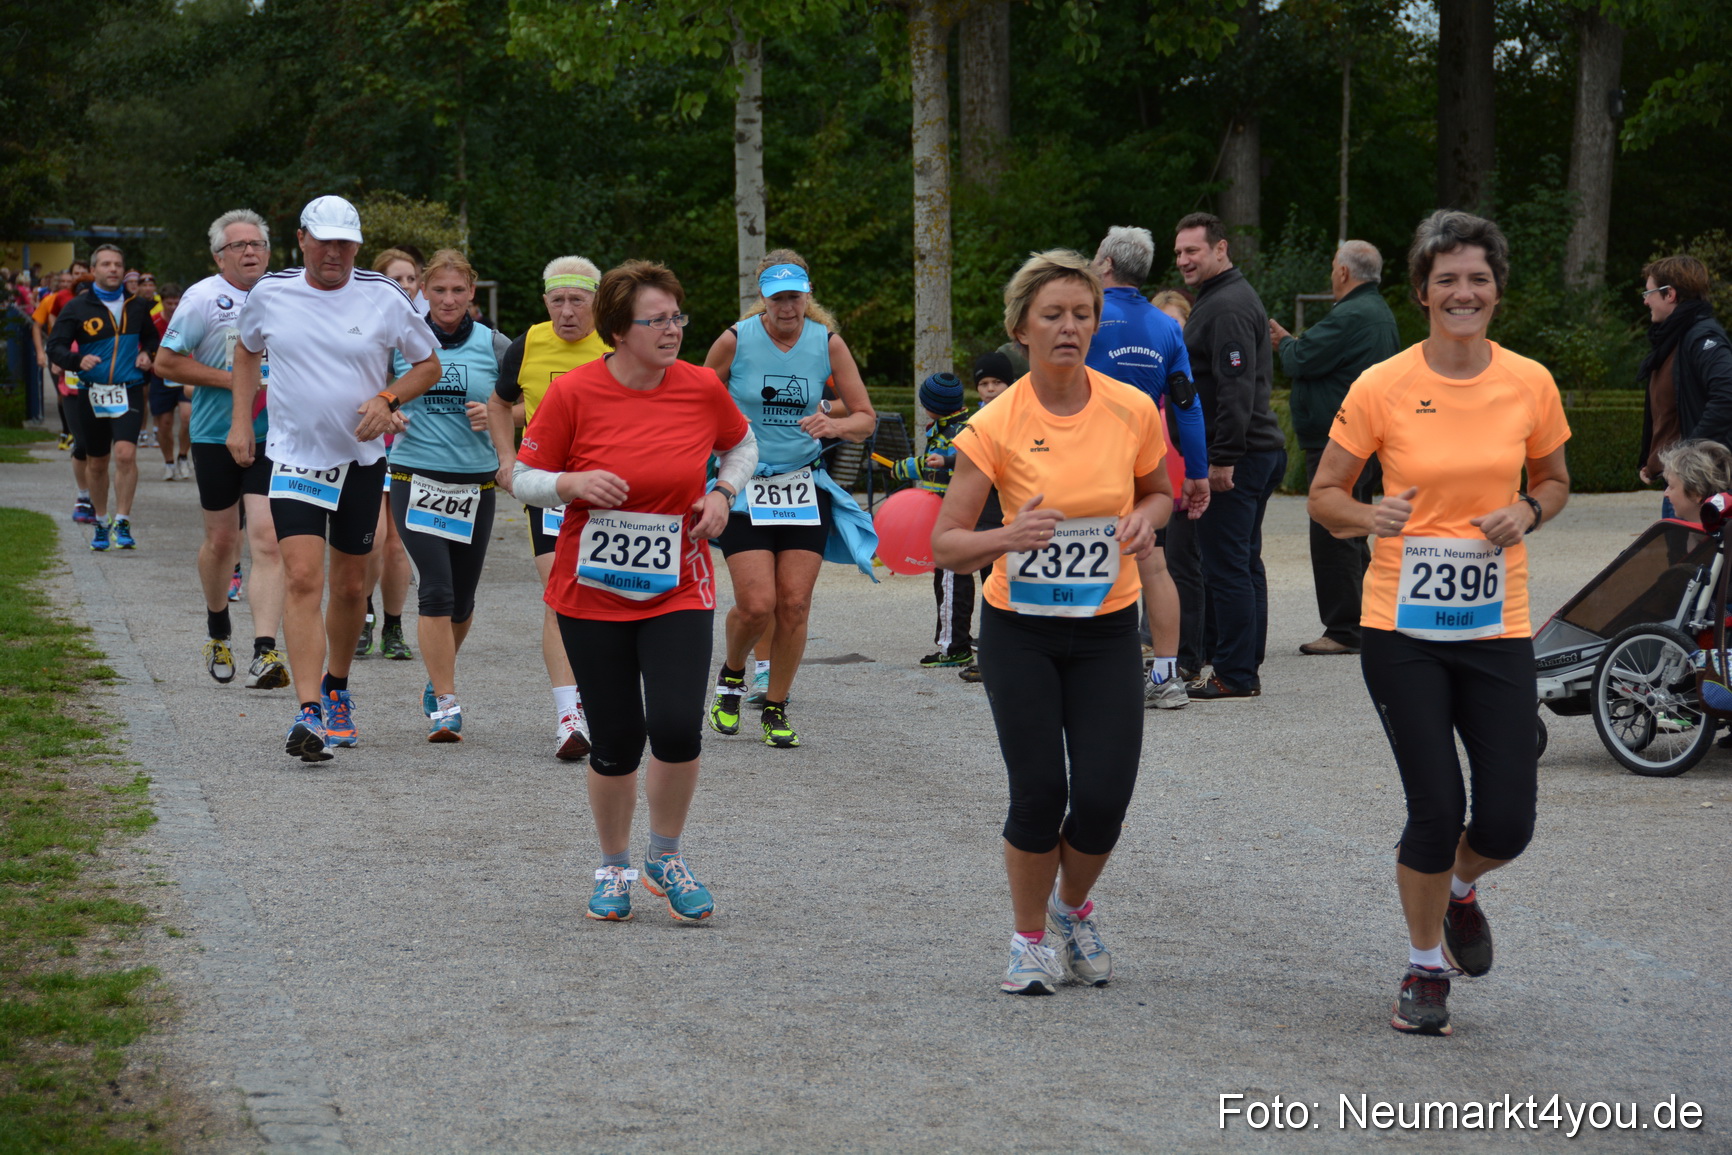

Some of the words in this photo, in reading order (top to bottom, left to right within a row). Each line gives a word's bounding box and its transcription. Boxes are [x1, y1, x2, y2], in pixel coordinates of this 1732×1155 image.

[1108, 346, 1164, 364] funrunners
[423, 396, 466, 405] HIRSCH
[763, 407, 803, 416] HIRSCH
[288, 479, 322, 496] Werner
[413, 480, 435, 492] PARTL
[436, 487, 469, 495] Neumarkt
[754, 483, 810, 505] 2612
[416, 489, 473, 518] 2264
[773, 510, 796, 518] Petra
[433, 517, 446, 529] Pia
[589, 518, 617, 528] PARTL
[619, 520, 666, 532] Neumarkt
[589, 530, 671, 570] 2323
[1405, 547, 1441, 557] PARTL
[1443, 548, 1494, 560] Neumarkt
[1019, 541, 1109, 578] 2322
[604, 573, 651, 590] Monika
[1410, 562, 1498, 601] 2396
[1053, 588, 1073, 602] Evi
[1435, 611, 1474, 626] Heidi
